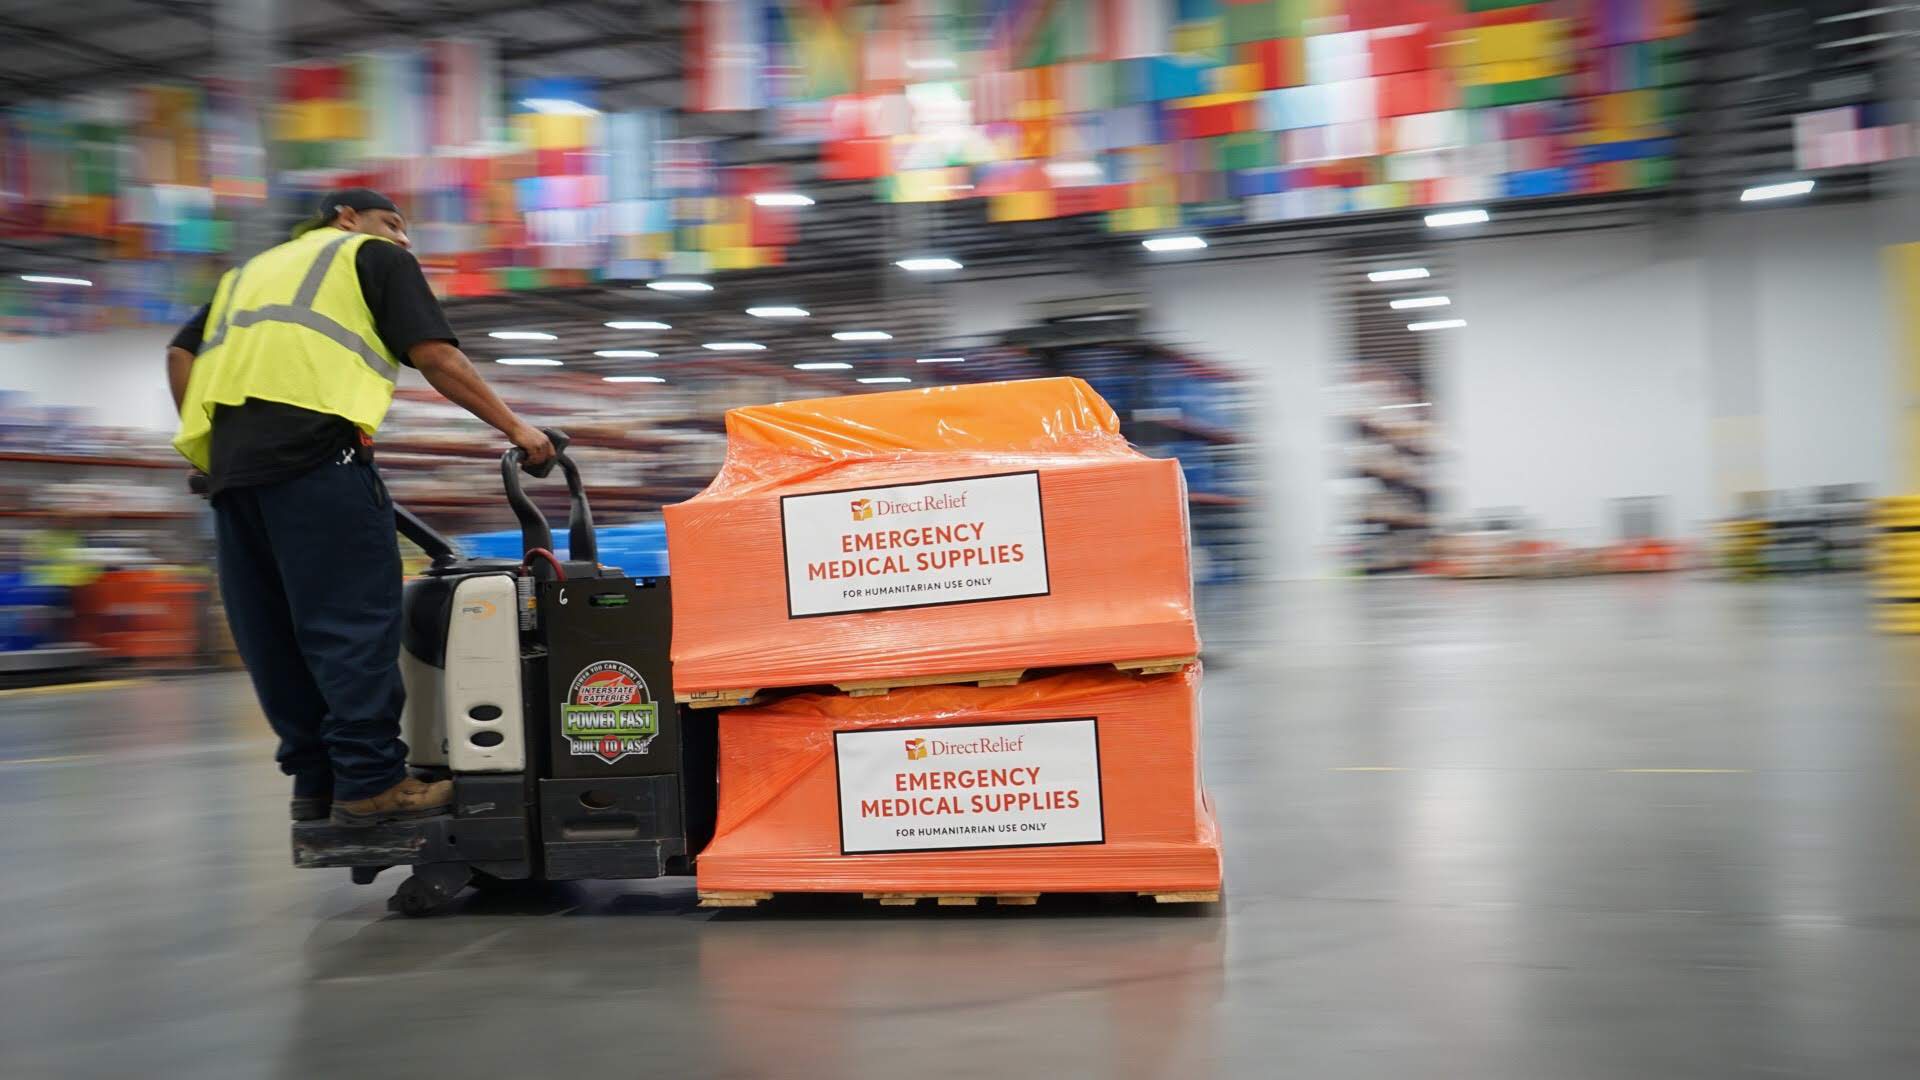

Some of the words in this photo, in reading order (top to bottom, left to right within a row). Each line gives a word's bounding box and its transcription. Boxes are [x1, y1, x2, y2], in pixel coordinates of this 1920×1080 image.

[841, 521, 985, 553] EMERGENCY
[808, 554, 910, 581] MEDICAL
[917, 543, 1025, 571] SUPPLIES
[843, 588, 862, 599] FOR
[865, 581, 942, 597] HUMANITARIAN
[944, 579, 963, 590] USE
[966, 577, 993, 588] ONLY
[590, 664, 603, 673] YOU
[583, 694, 630, 702] BATTERIES
[568, 711, 616, 729] POWER
[620, 710, 652, 729] FAST
[572, 740, 599, 753] BUILT
[605, 740, 618, 753] TO
[621, 740, 648, 753] LAST
[895, 766, 1041, 792] EMERGENCY
[861, 796, 964, 818] MEDICAL
[971, 790, 1080, 814] SUPPLIES
[896, 828, 915, 837] FOR
[918, 824, 996, 836] HUMANITARIAN
[998, 823, 1017, 833] USE
[1020, 822, 1048, 832] ONLY
